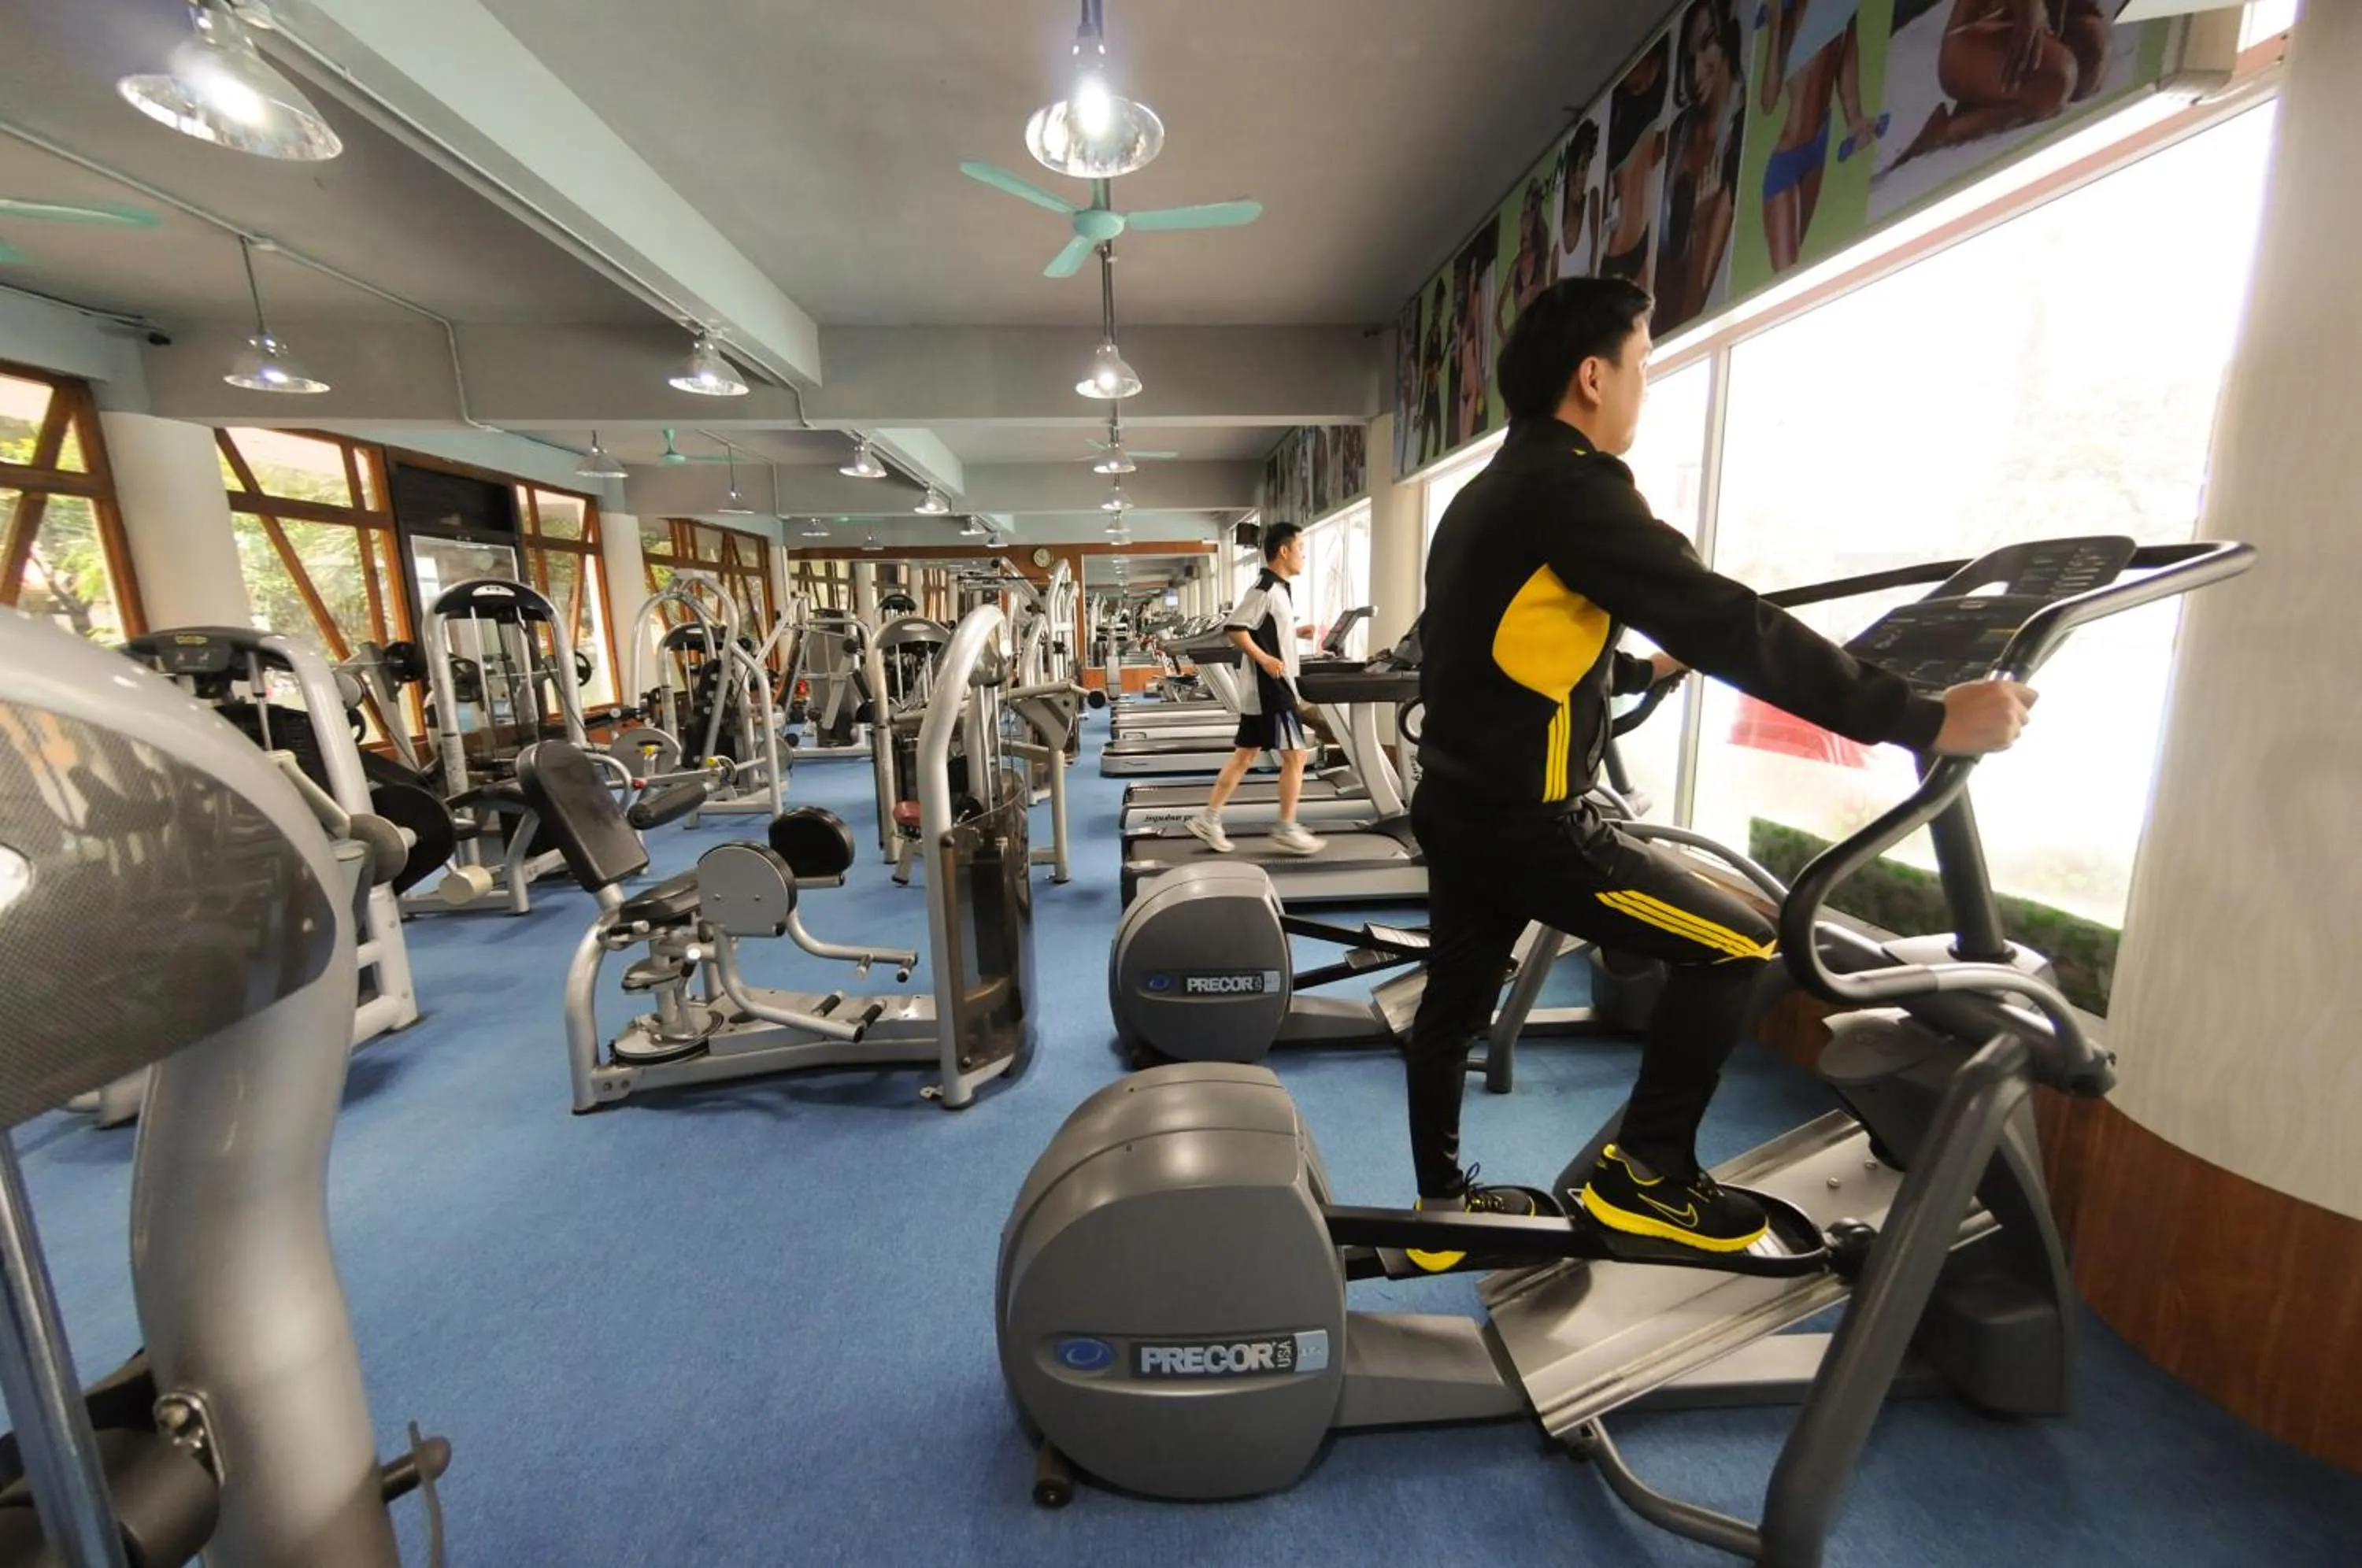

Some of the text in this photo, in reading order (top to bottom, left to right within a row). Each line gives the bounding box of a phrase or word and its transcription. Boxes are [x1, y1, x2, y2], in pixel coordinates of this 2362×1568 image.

[1187, 976, 1253, 992] PRECOR
[1141, 1344, 1275, 1374] PRECOR
[1277, 1340, 1292, 1368] USA
